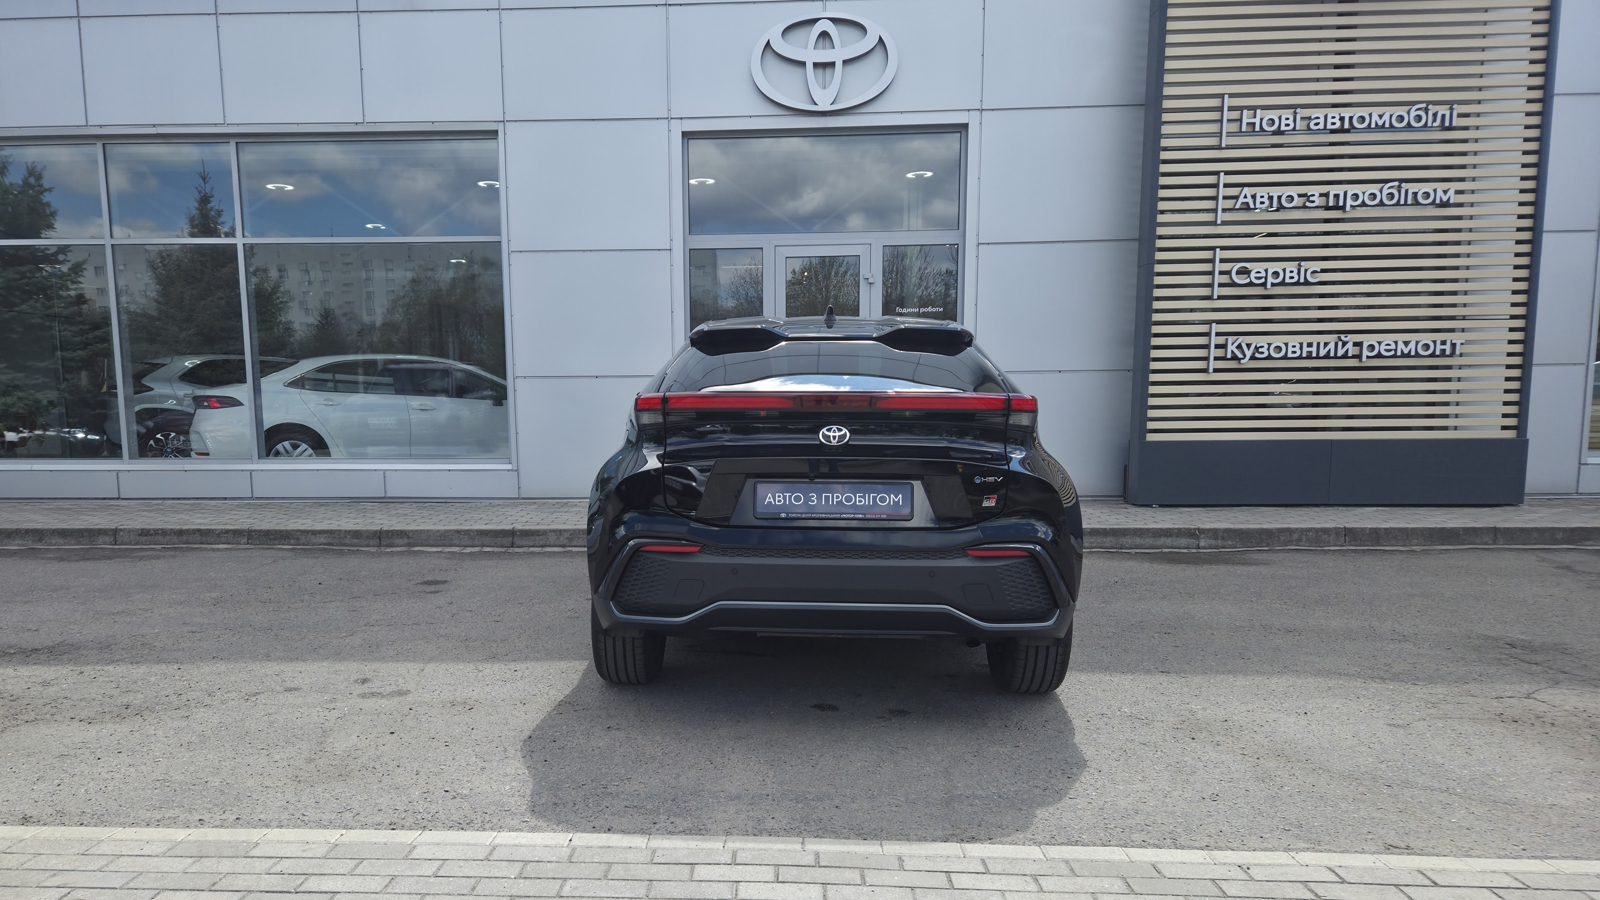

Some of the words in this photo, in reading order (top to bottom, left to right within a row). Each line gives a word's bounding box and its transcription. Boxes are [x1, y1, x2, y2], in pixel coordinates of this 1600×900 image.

[1240, 108, 1301, 132] Нові
[1308, 103, 1458, 130] автомобілі
[1234, 187, 1298, 209] Авто
[1305, 190, 1320, 208] з
[1327, 181, 1455, 212] пробігом
[1230, 261, 1321, 289] Сервіс
[1225, 335, 1353, 364] Кузовний
[1359, 338, 1465, 362] ремонт
[764, 493, 804, 505] АВТО
[822, 493, 903, 506] ПРОБІГОМ
